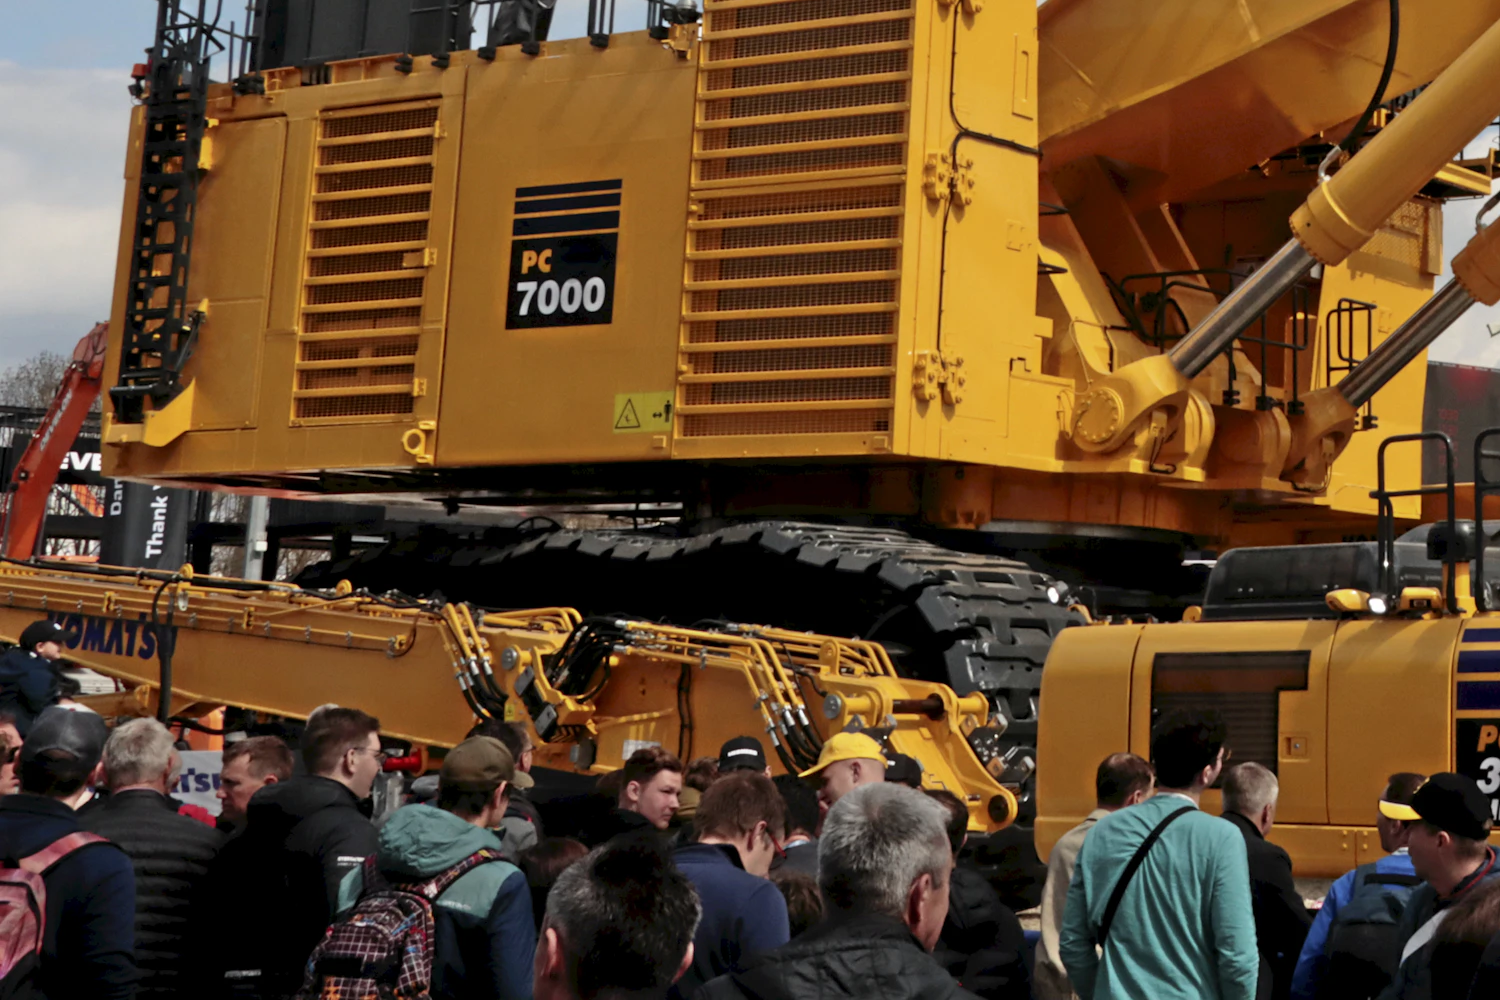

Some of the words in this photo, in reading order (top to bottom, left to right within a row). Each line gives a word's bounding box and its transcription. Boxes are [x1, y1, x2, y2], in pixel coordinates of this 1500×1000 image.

[521, 248, 553, 275] PC
[516, 276, 606, 316] 7000
[145, 495, 169, 559] Thank
[47, 611, 179, 660] OMATS
